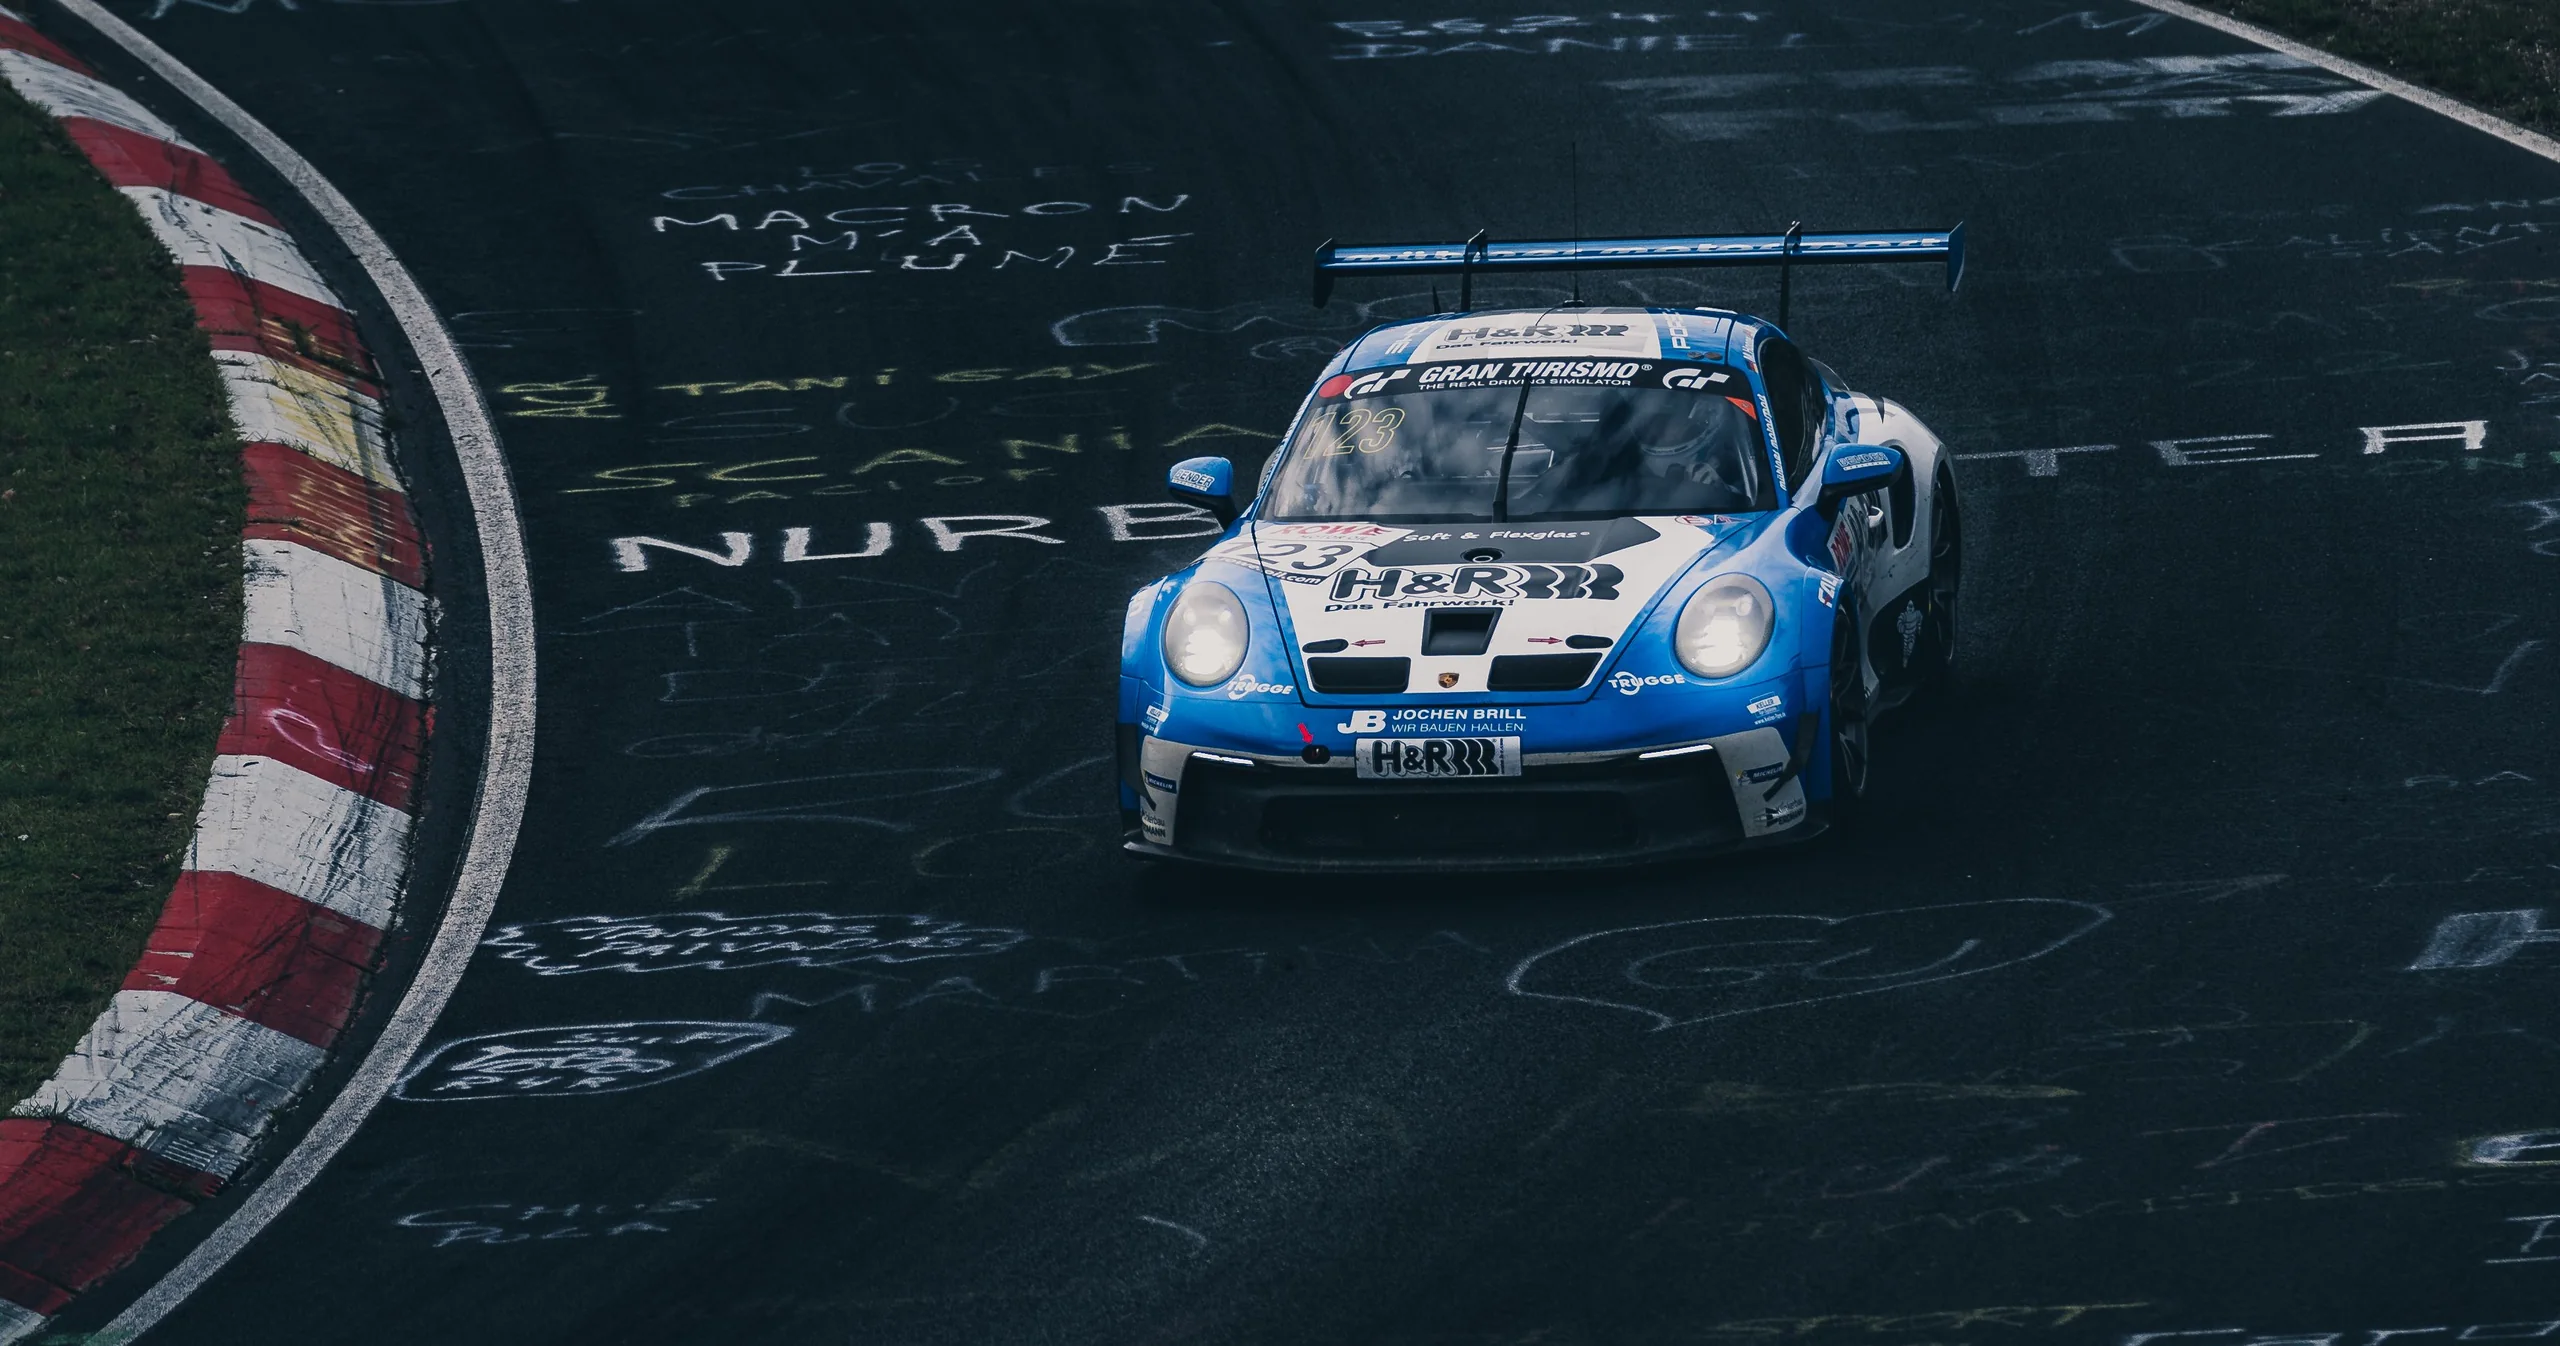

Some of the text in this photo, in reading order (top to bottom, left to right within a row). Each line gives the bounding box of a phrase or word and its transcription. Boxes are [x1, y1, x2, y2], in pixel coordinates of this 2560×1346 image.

[651, 194, 1190, 233] MACRON
[1436, 338, 1578, 351] Das Fahrwerk!
[1419, 363, 1507, 383] GRAN
[1418, 376, 1632, 391] THE REAL DRIVING SIMULATOR
[1303, 406, 1404, 460] 123
[1174, 469, 1216, 488] BENDER
[1271, 525, 1392, 536] ROWE
[1403, 530, 1451, 543] Soft
[1459, 529, 1480, 540] &
[1218, 541, 1354, 570] 123
[1330, 565, 1522, 603] H&R
[1325, 598, 1515, 613] Das Fahrwerk!
[1227, 677, 1294, 697] TRUGGE
[1608, 673, 1687, 692] TRUGGE
[1337, 710, 1388, 734] JB
[1392, 708, 1527, 721] JOCHEN BRILL
[1392, 722, 1527, 733] WIR BAUEN HALLEN.
[1372, 739, 1458, 777] H&R
